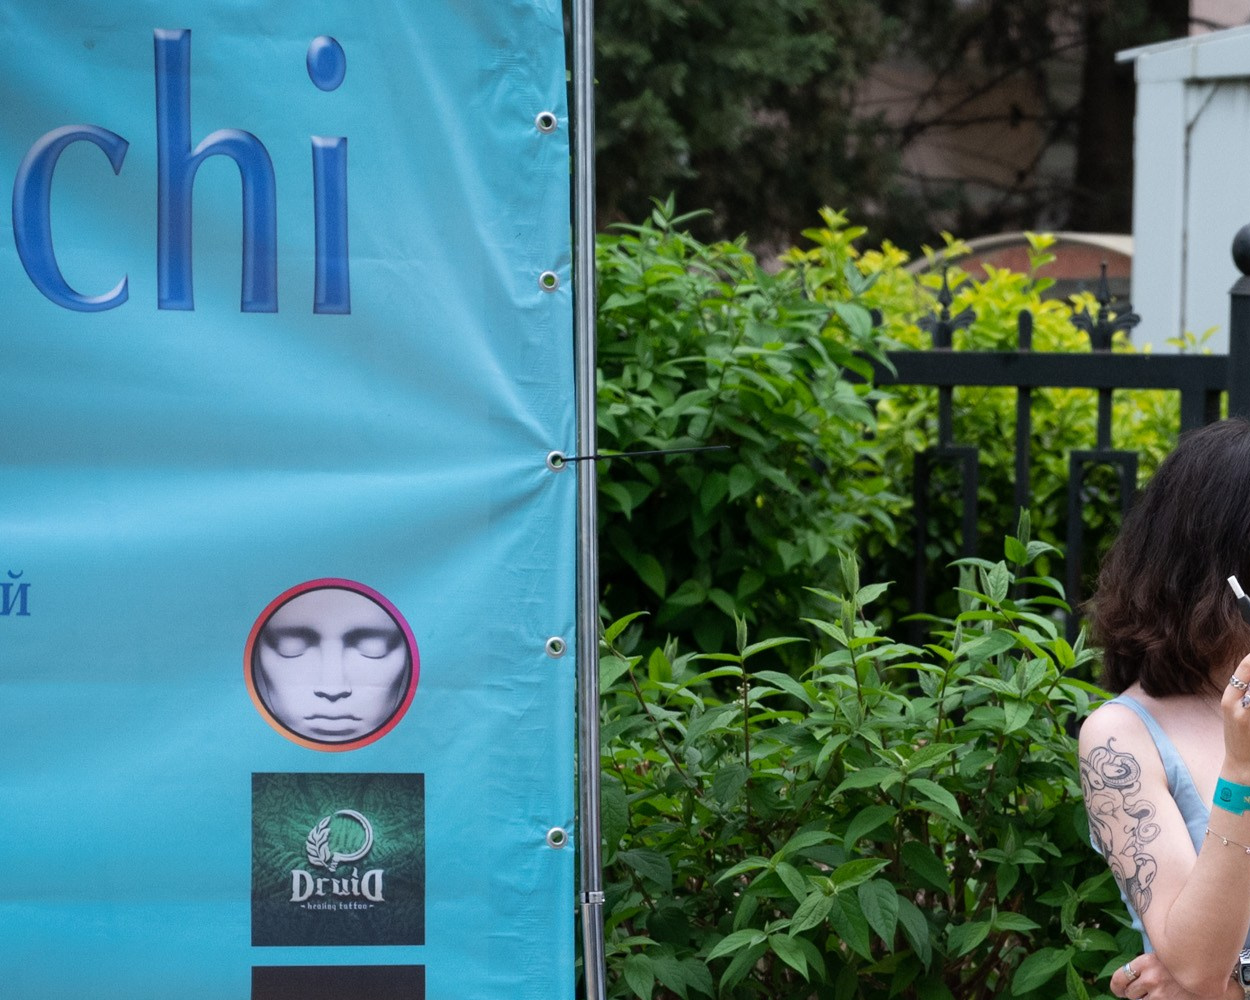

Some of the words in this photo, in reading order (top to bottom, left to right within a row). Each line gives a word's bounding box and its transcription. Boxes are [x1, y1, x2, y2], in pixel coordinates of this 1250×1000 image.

[12, 28, 352, 315] chi
[307, 902, 337, 911] healing
[339, 902, 368, 910] tattoo
